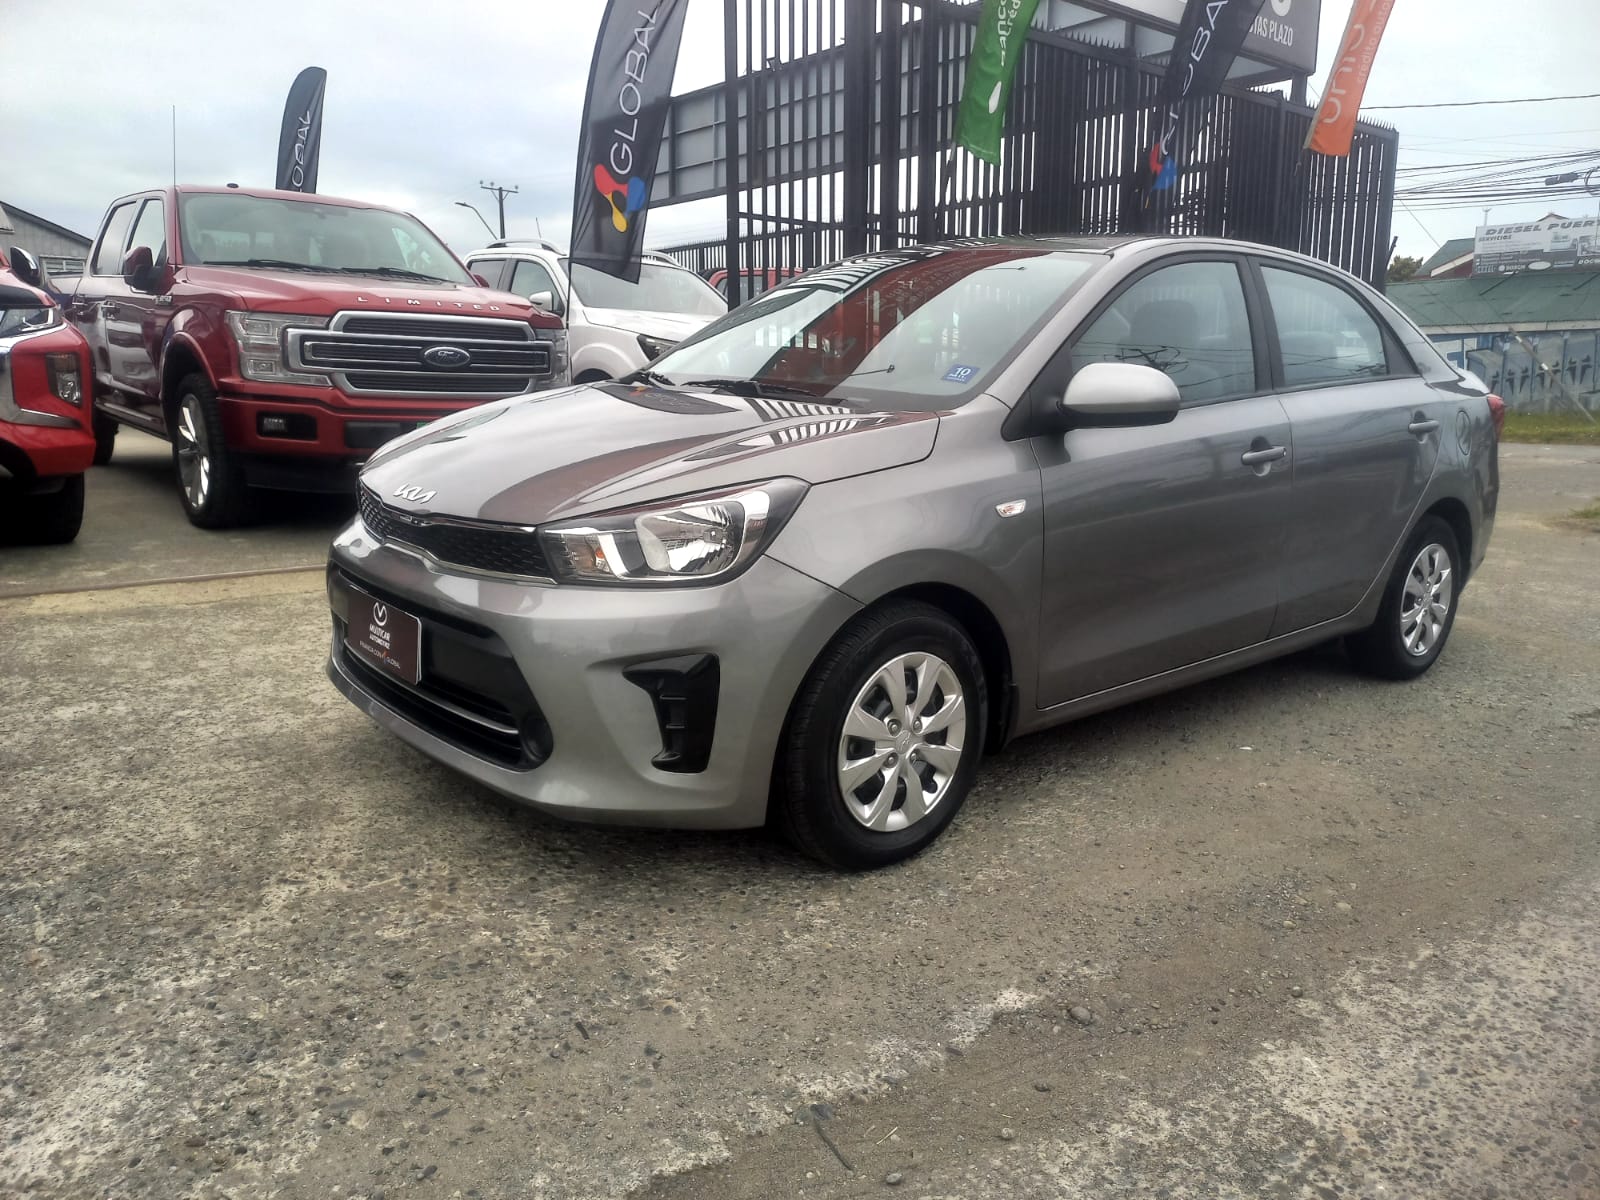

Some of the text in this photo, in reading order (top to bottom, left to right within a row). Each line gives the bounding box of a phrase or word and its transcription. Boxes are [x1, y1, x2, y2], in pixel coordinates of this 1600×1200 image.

[1269, 20, 1294, 47] PLAZO
[610, 9, 658, 175] GLOBAL
[291, 110, 311, 192] OBAL
[1485, 225, 1542, 236] DIESEL
[357, 296, 500, 311] LIMITED
